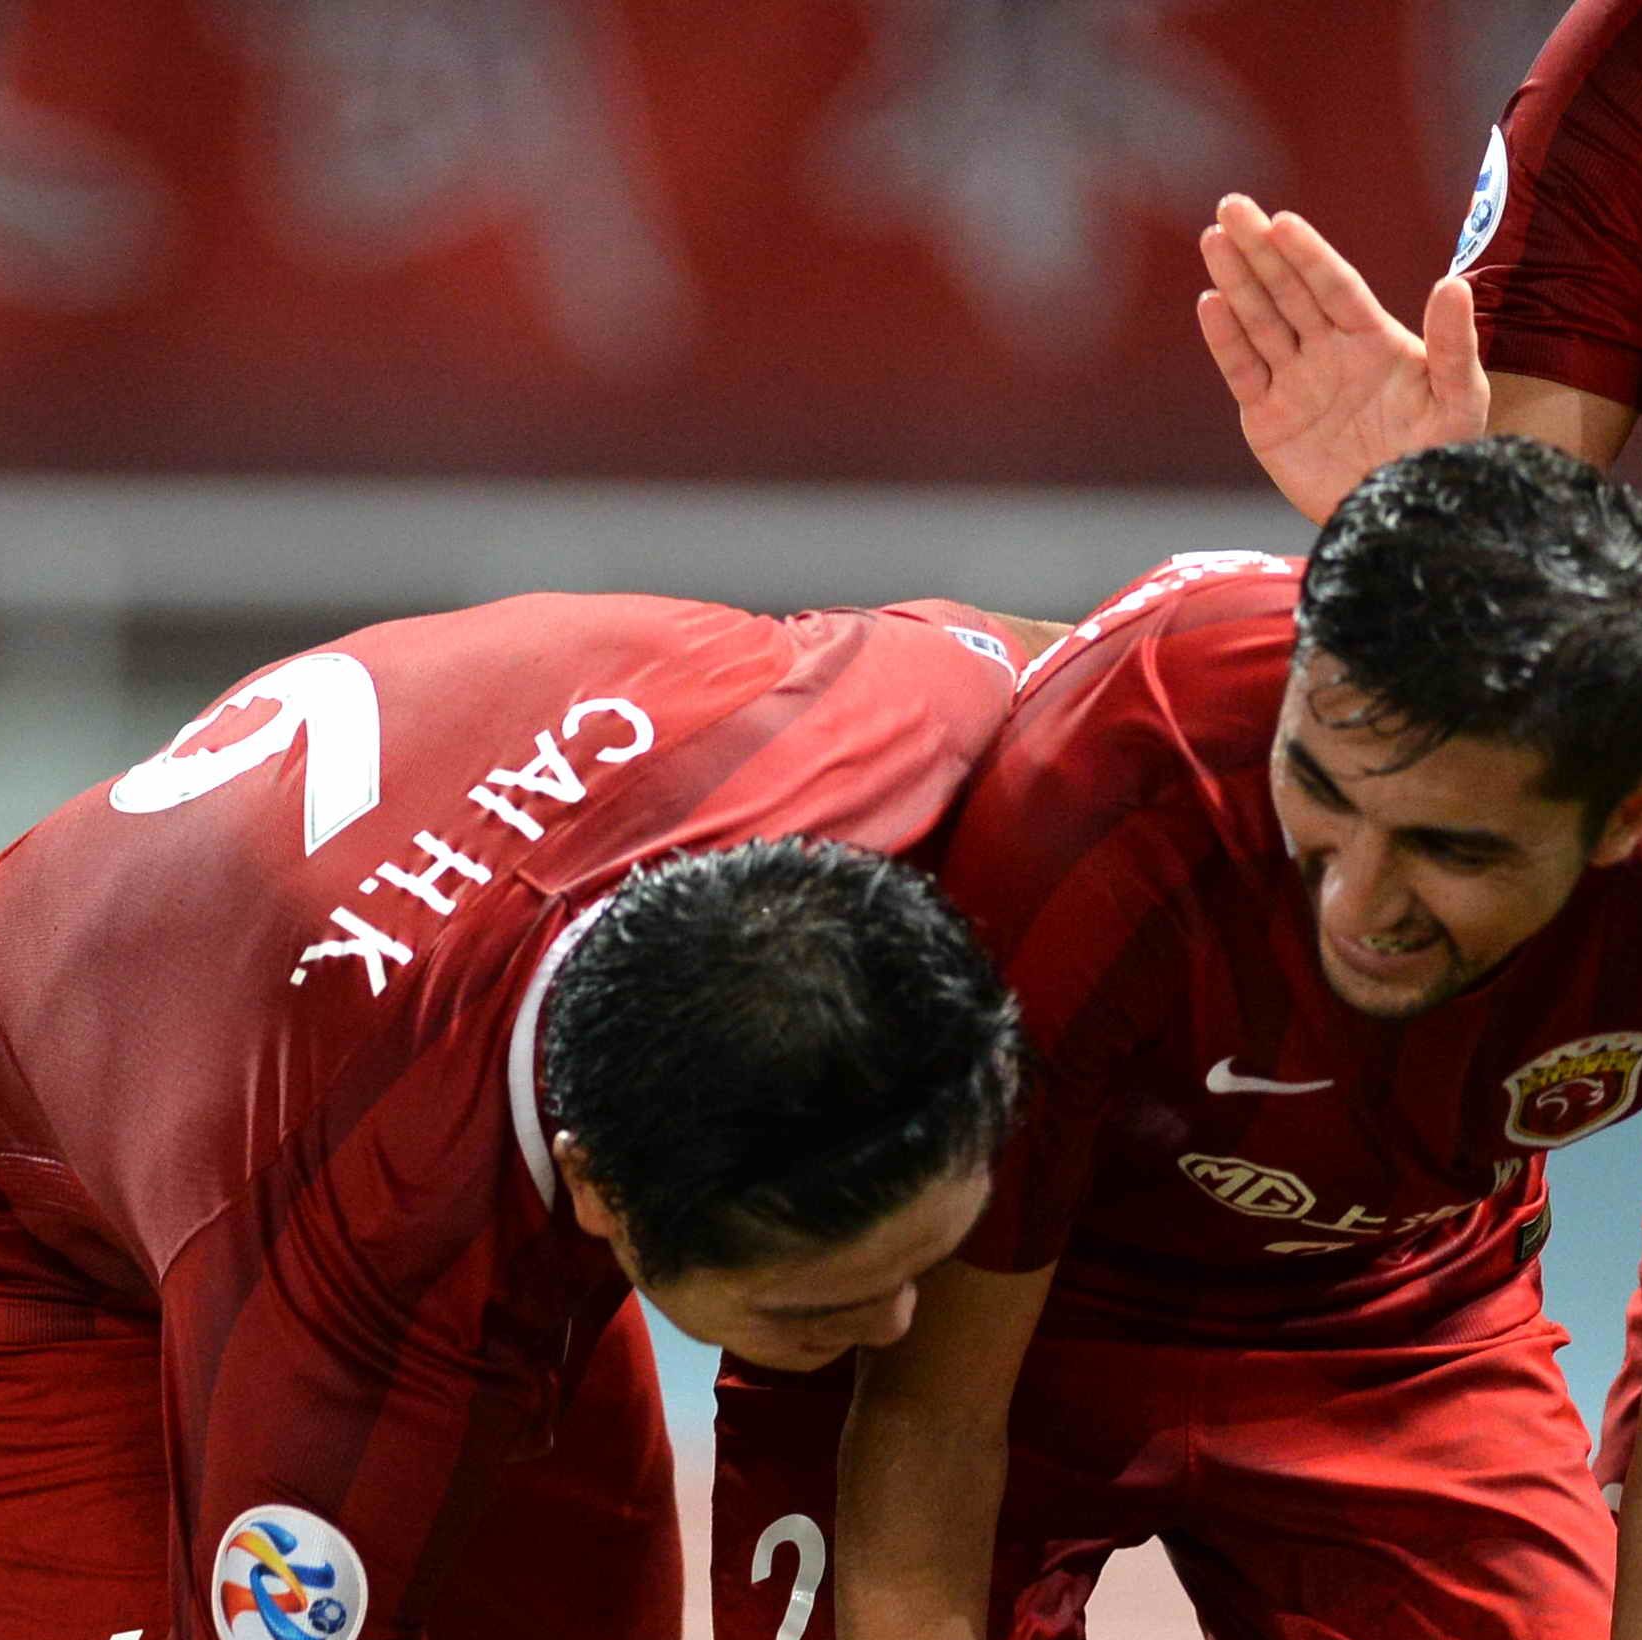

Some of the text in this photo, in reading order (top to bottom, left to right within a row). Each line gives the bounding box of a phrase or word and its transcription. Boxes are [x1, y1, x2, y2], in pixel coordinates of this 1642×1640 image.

[290, 697, 655, 998] CAI H.K.
[1187, 1157, 1305, 1216] MG
